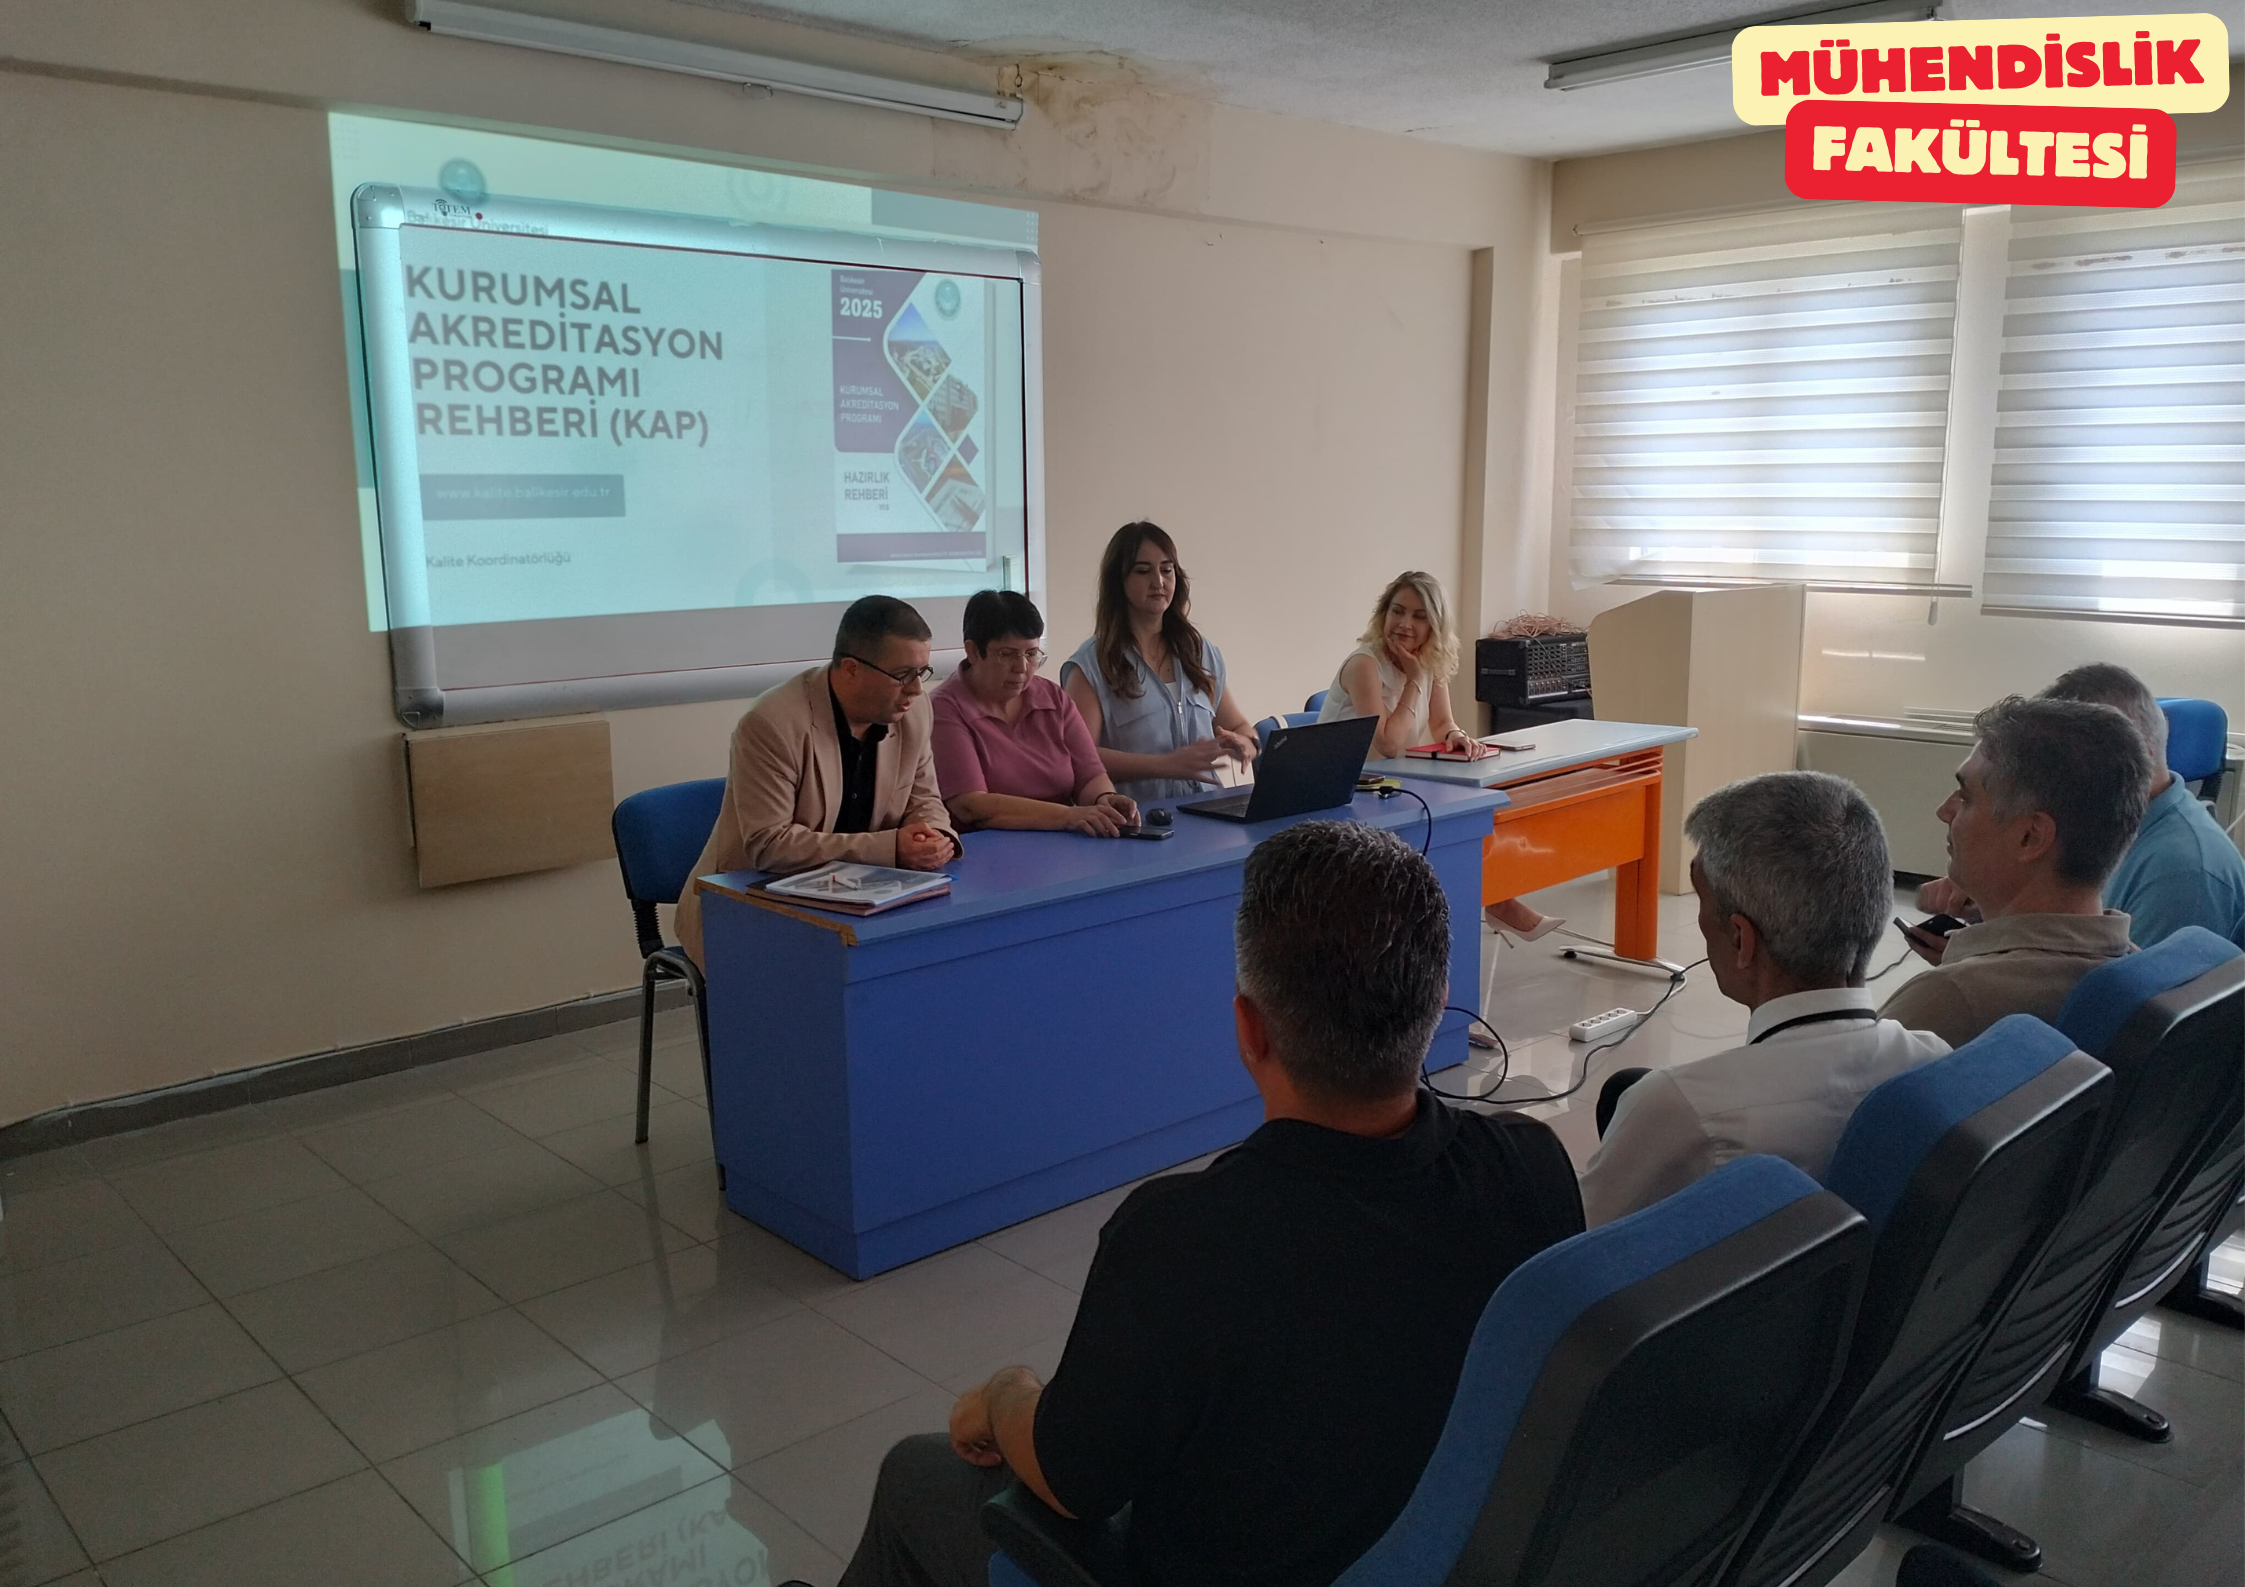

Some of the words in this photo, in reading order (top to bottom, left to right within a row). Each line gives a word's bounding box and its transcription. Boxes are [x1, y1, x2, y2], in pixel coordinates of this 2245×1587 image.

[405, 264, 641, 314] KURUMSAL
[840, 297, 883, 319] 2025
[408, 311, 723, 361] AKREDİTASYON
[412, 357, 641, 398] PROGRAMI
[840, 385, 884, 397] KURUMSAL
[416, 399, 598, 438] REHBERİ
[610, 407, 709, 448] (KAP)
[841, 412, 882, 423] PROGRAMI
[844, 471, 890, 484] HAZIRLIK
[844, 486, 889, 500] REHBERİ
[426, 555, 464, 568] Kalite
[467, 552, 571, 567] Koordinatörlüğü
